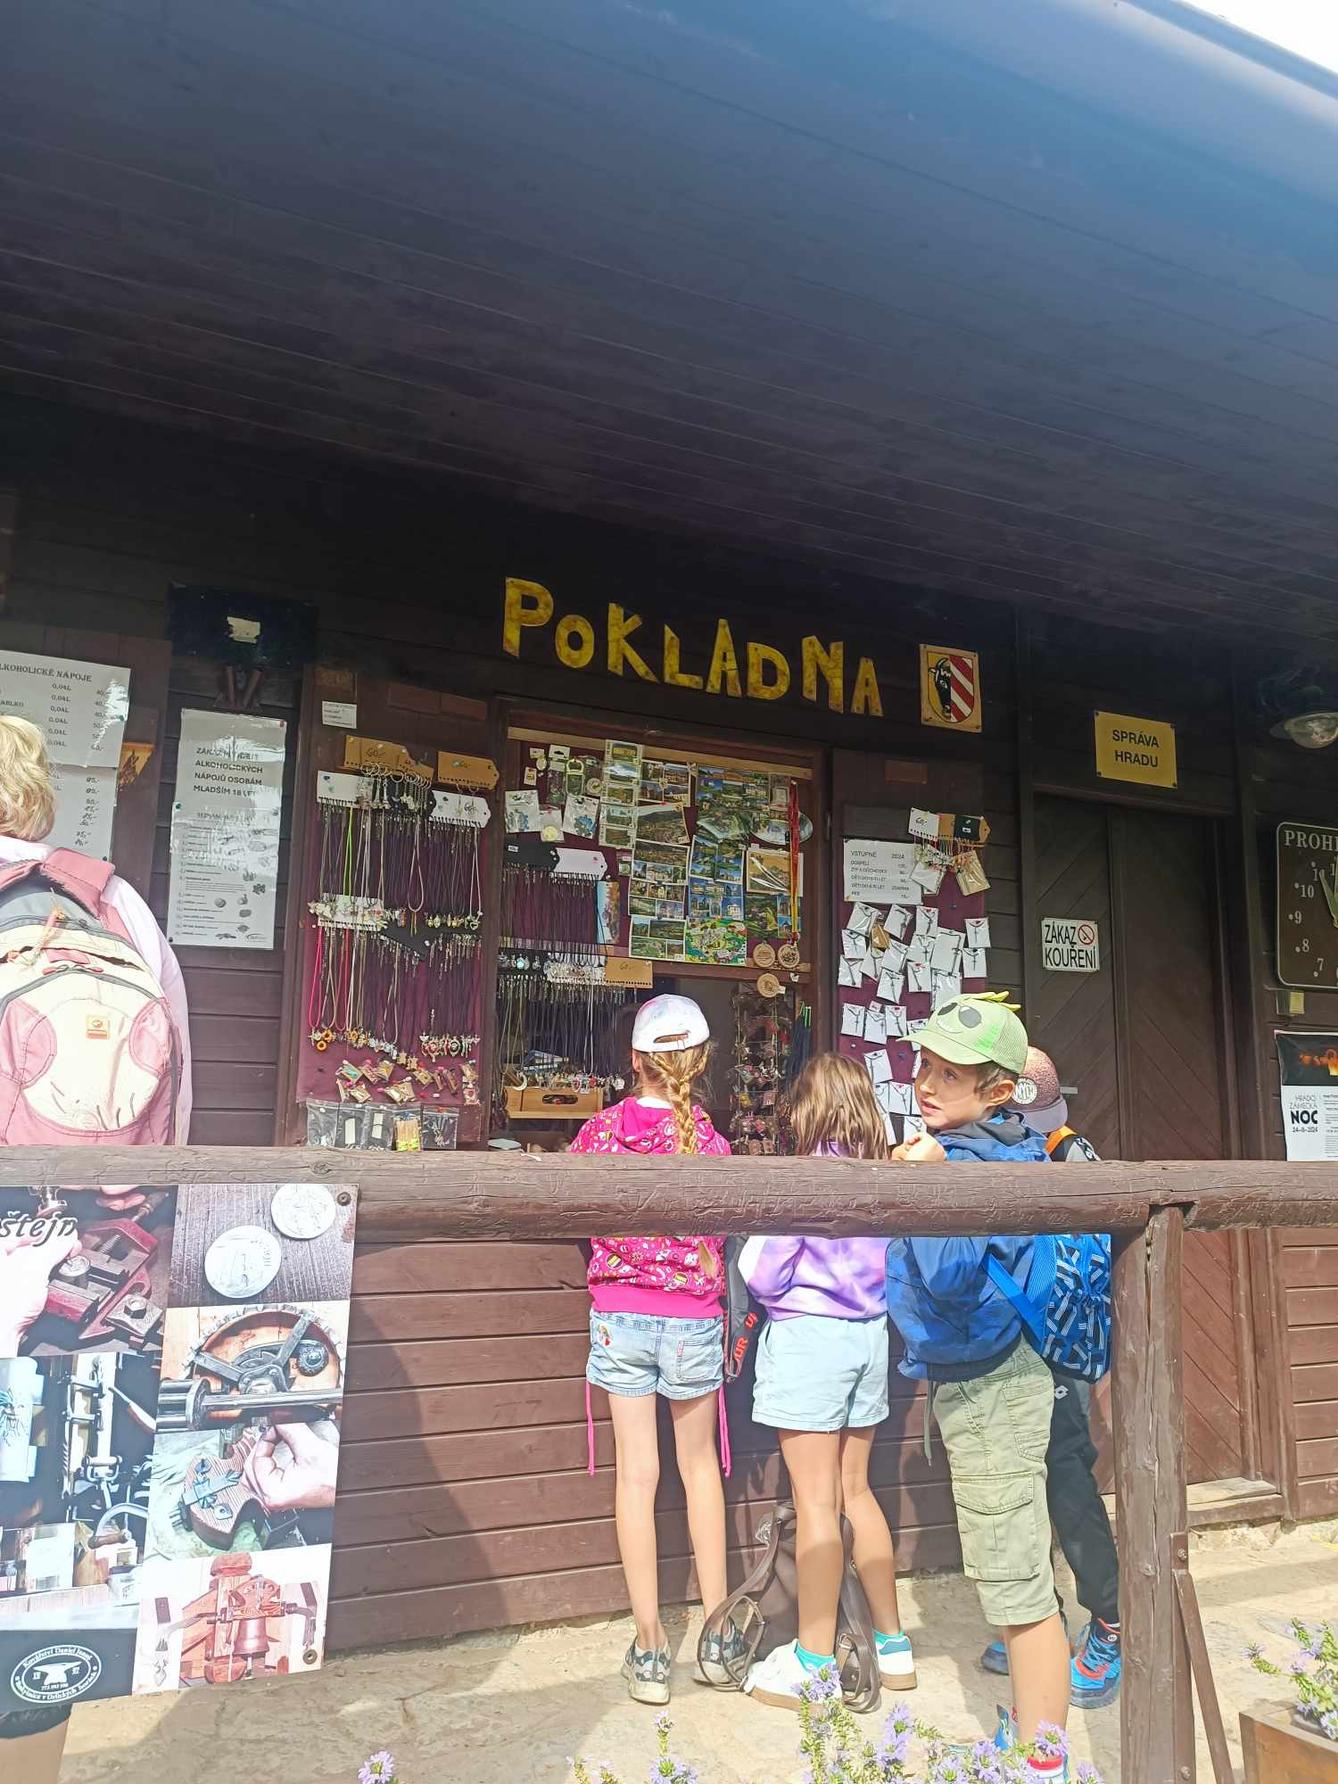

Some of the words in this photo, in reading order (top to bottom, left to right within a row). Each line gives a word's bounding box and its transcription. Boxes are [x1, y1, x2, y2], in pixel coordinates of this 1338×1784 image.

[56, 669, 93, 682] NÁPOJE
[1112, 729, 1159, 748] SPRÁVA
[1114, 749, 1158, 768] HRADU
[194, 771, 226, 782] NÁPOJŮ
[227, 775, 262, 786] OSOBÁM
[193, 784, 230, 795] MLADŠÍM
[1284, 829, 1338, 851] PROH
[1300, 884, 1314, 899] 10
[1294, 910, 1302, 925] 9
[1044, 921, 1077, 945] ZÁKAZ
[1302, 938, 1310, 953] 8
[1044, 945, 1096, 969] KOUŘENÍ
[1317, 957, 1325, 971] 7
[1290, 1110, 1318, 1125] NOC
